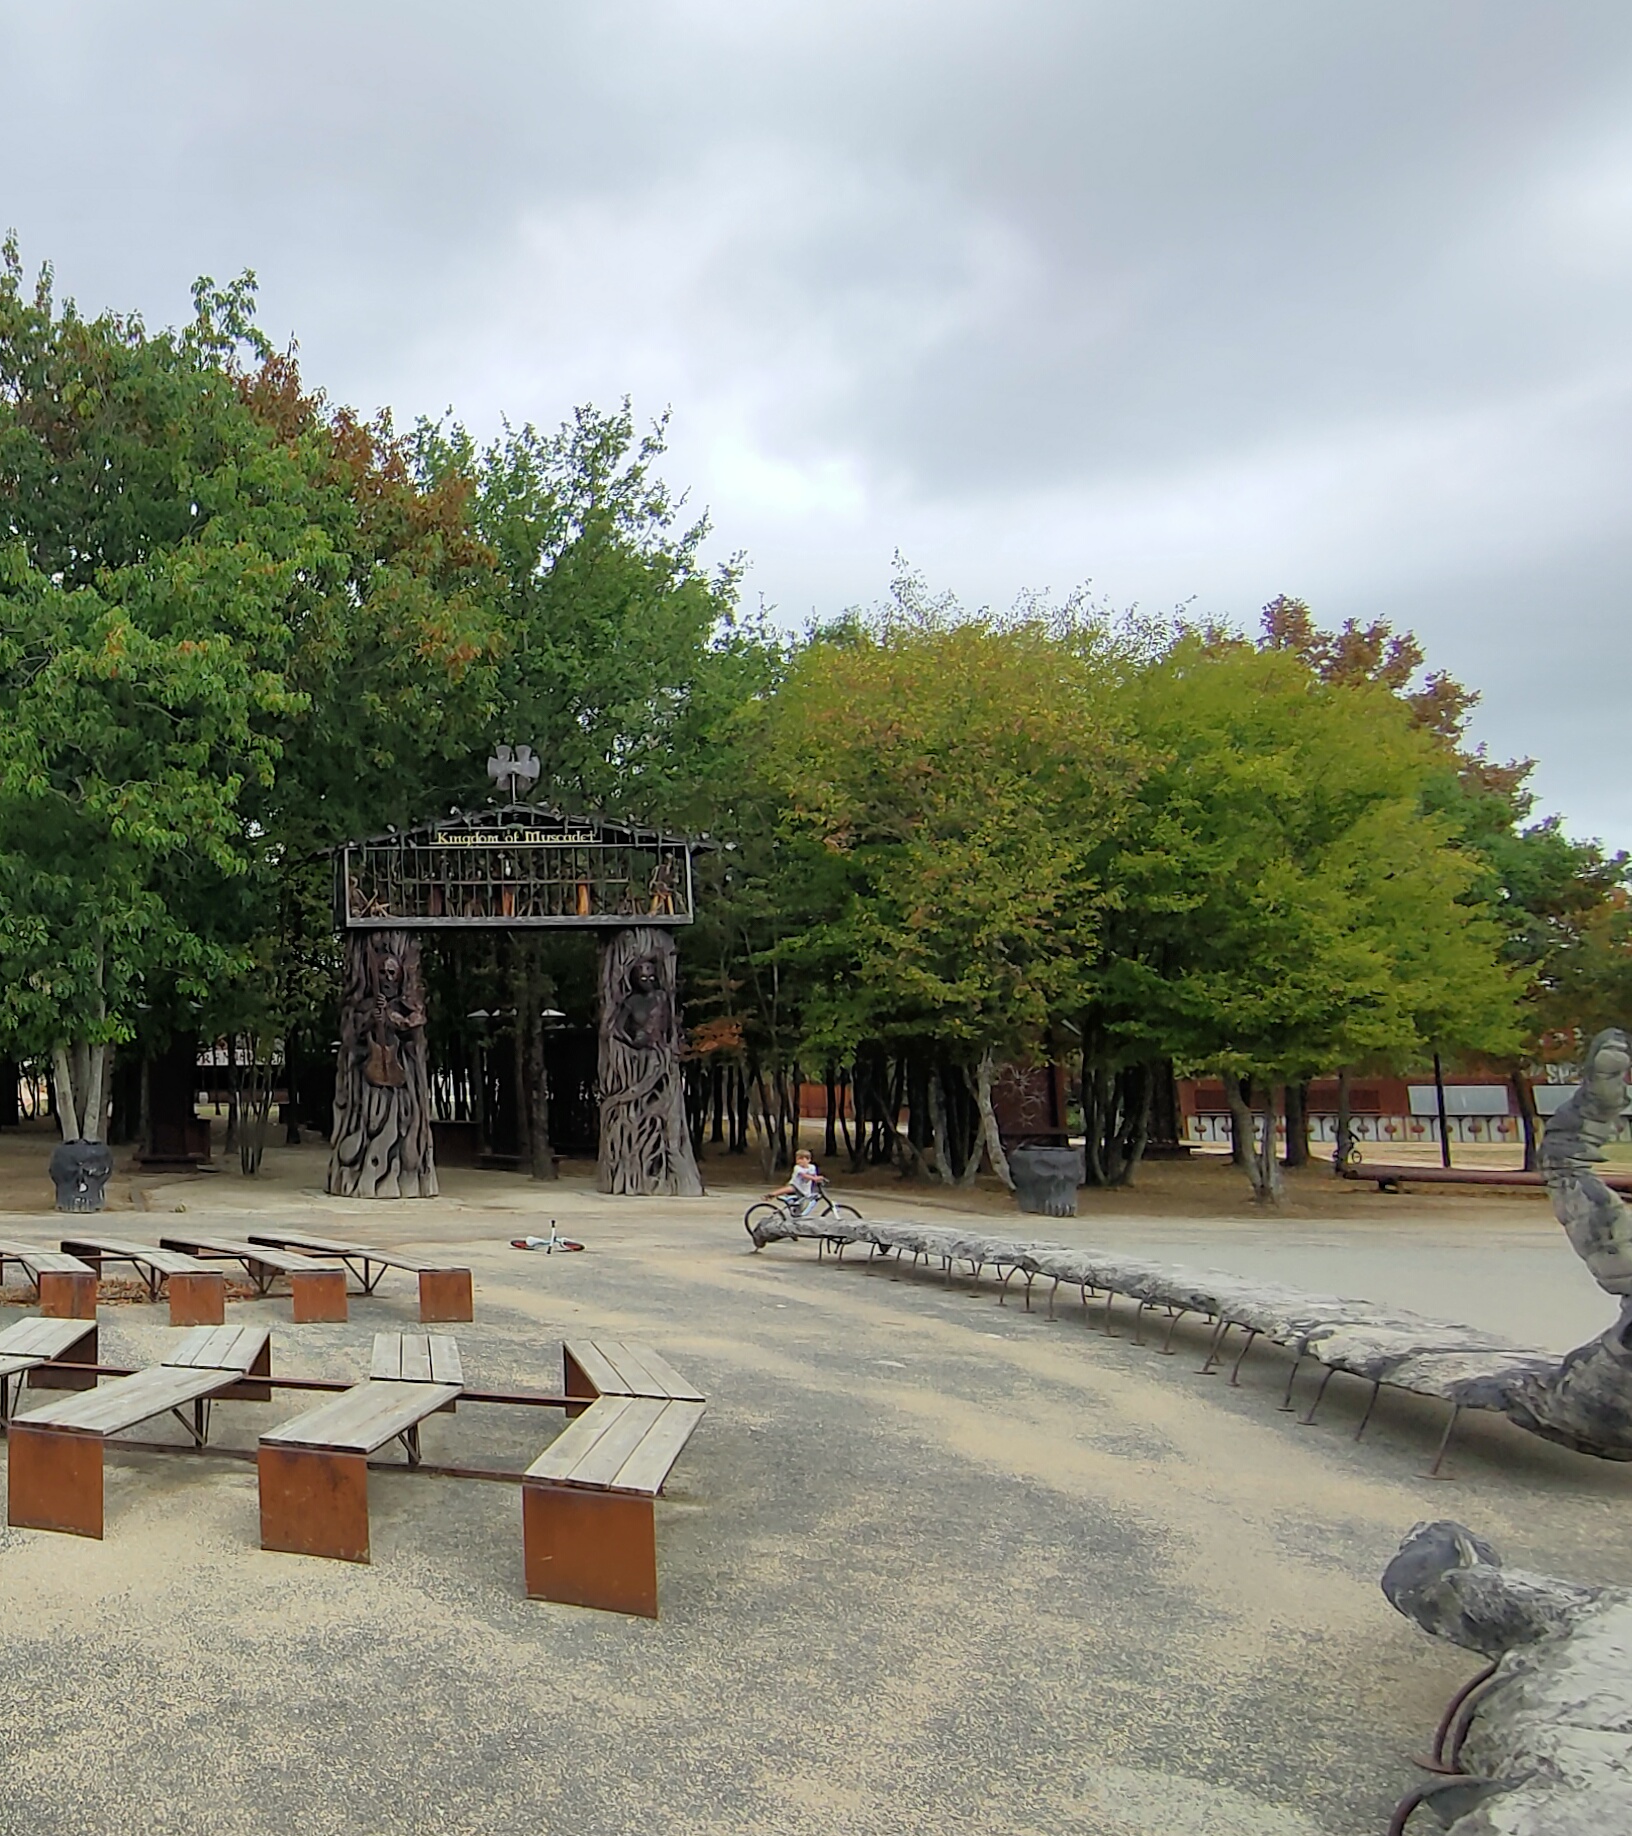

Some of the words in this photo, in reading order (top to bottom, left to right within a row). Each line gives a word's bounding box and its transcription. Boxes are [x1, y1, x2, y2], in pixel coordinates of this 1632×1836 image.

[438, 831, 499, 847] Kingdom
[505, 831, 519, 843] of
[525, 830, 596, 843] Muscadet
